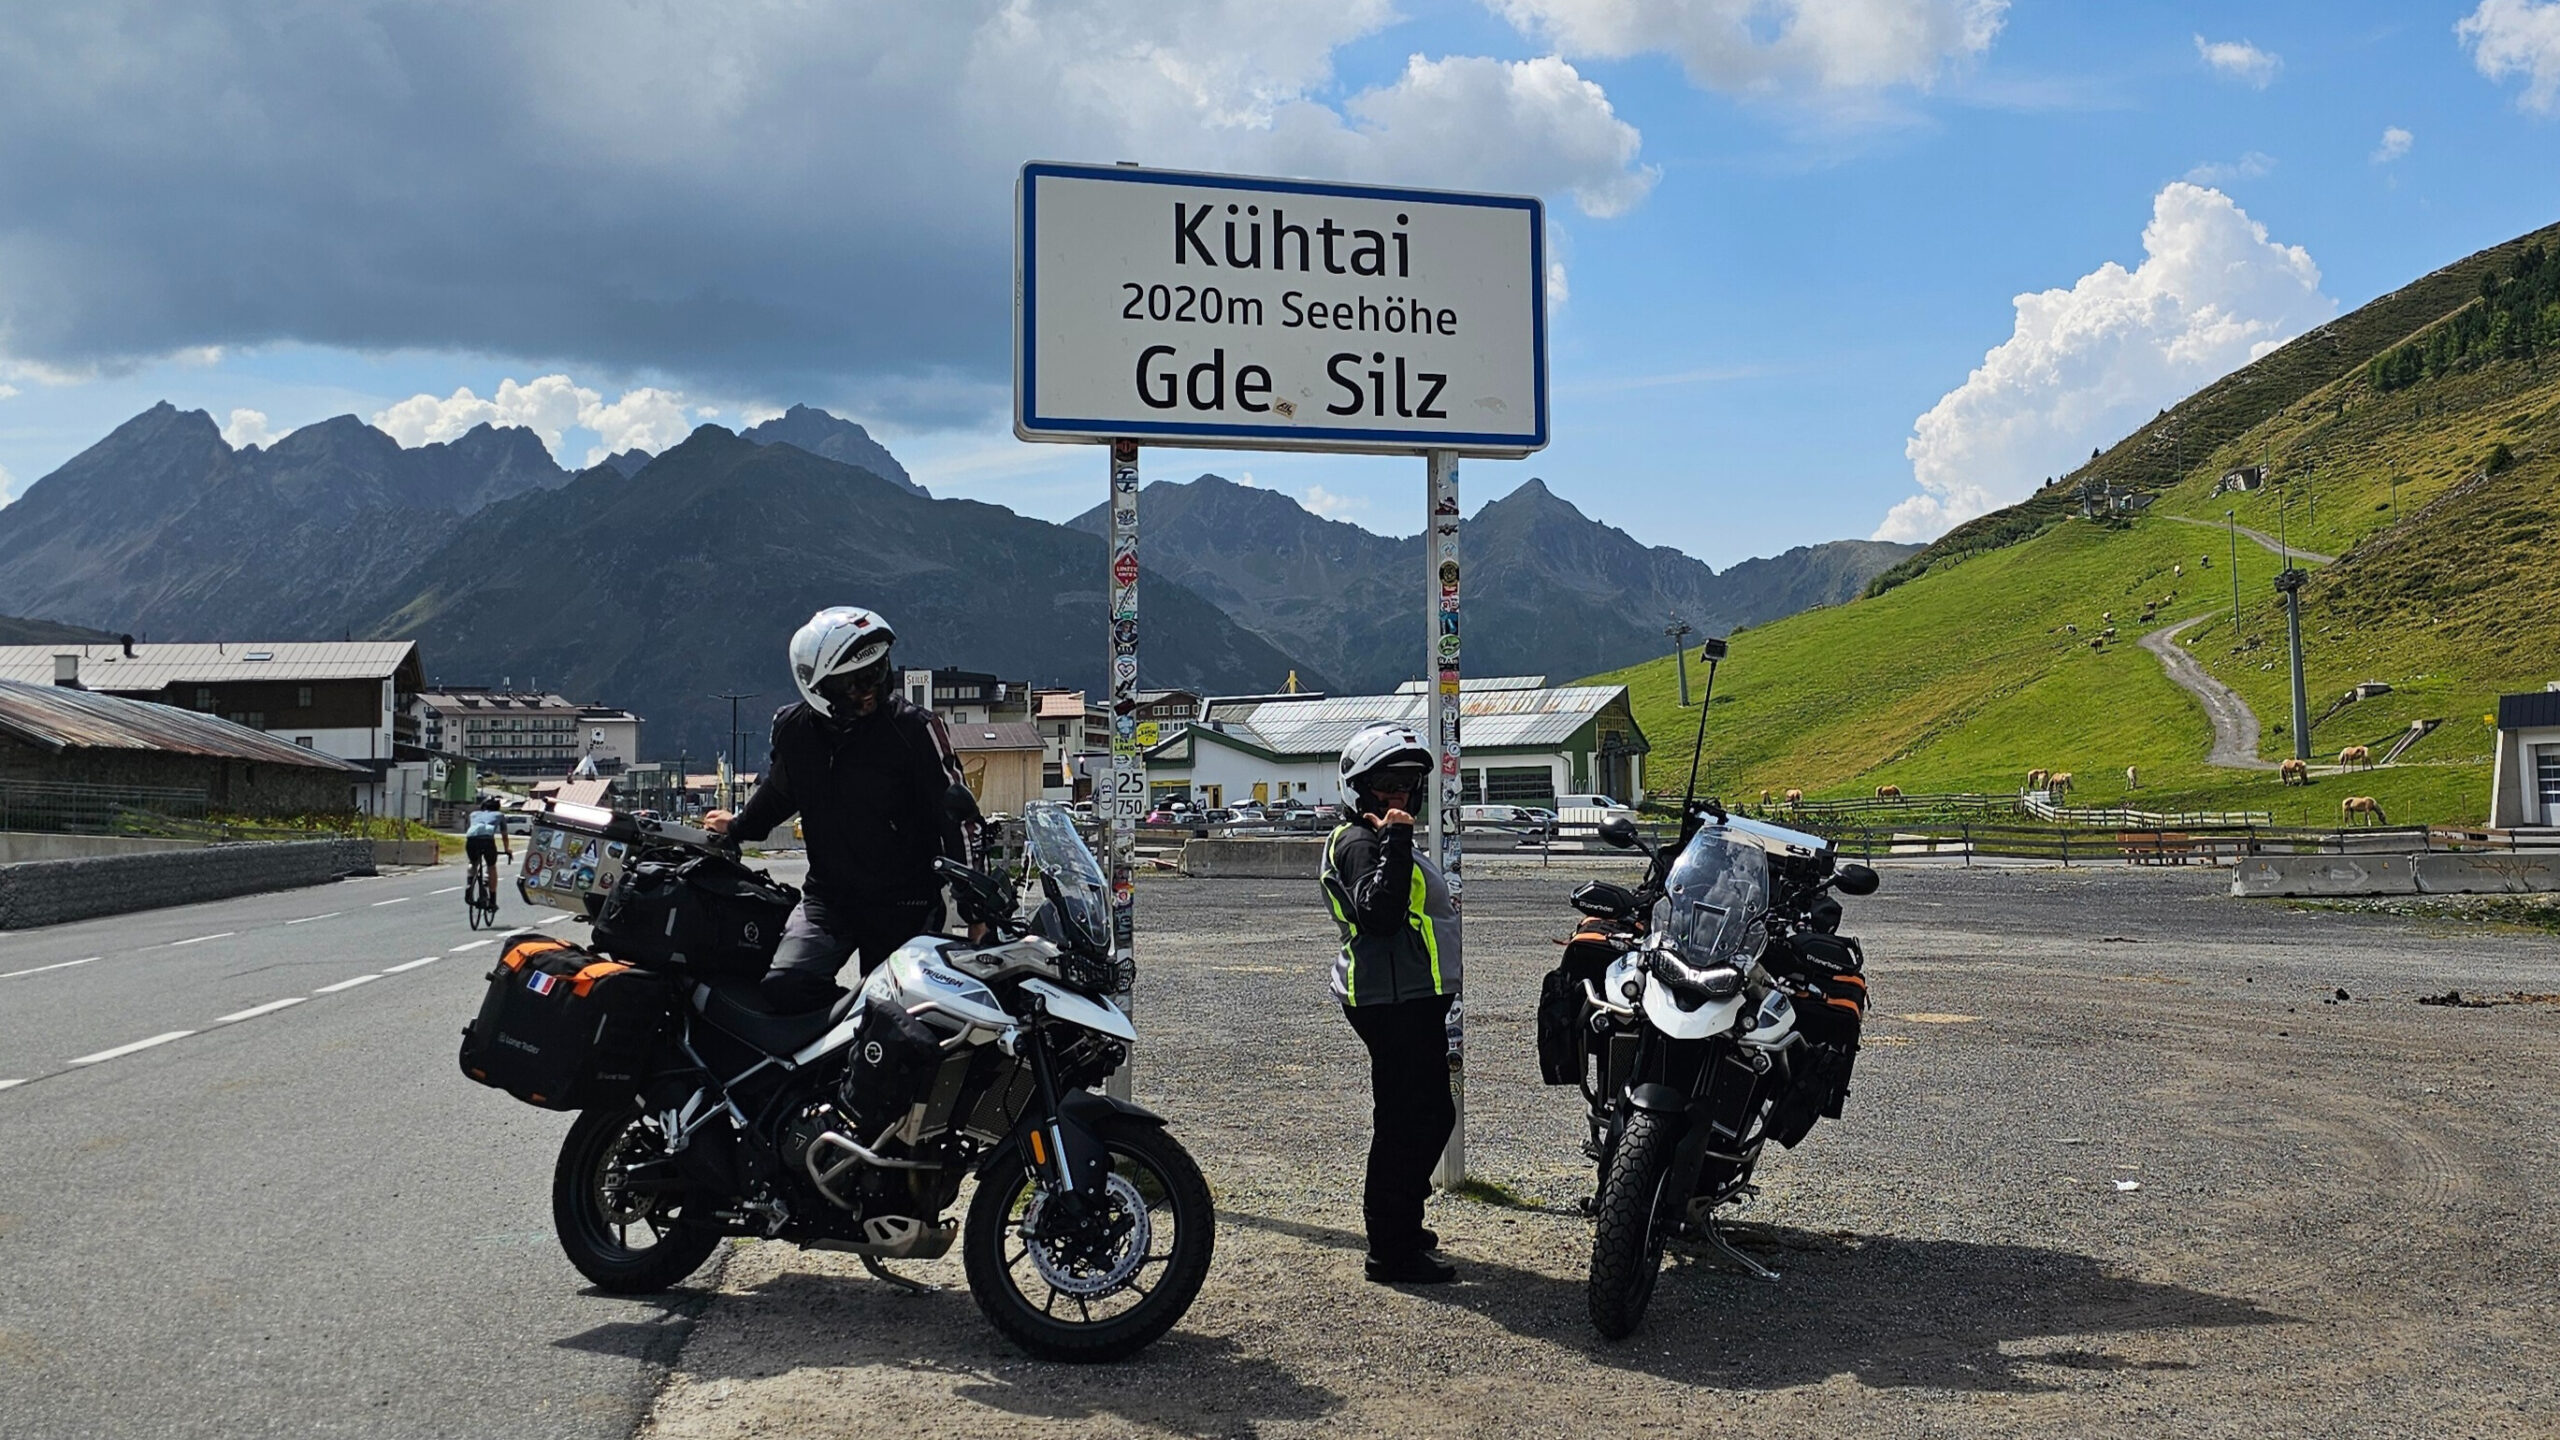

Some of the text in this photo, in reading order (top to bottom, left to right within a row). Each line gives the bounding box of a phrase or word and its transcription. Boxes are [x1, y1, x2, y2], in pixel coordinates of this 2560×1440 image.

[1175, 202, 1409, 278] Kühtai
[1122, 282, 1457, 336] 2020m Seehöhe
[1135, 345, 1448, 420] Gde Silz
[1118, 773, 1144, 793] 25
[1117, 799, 1142, 815] 750
[922, 967, 964, 988] TRIUMPH
